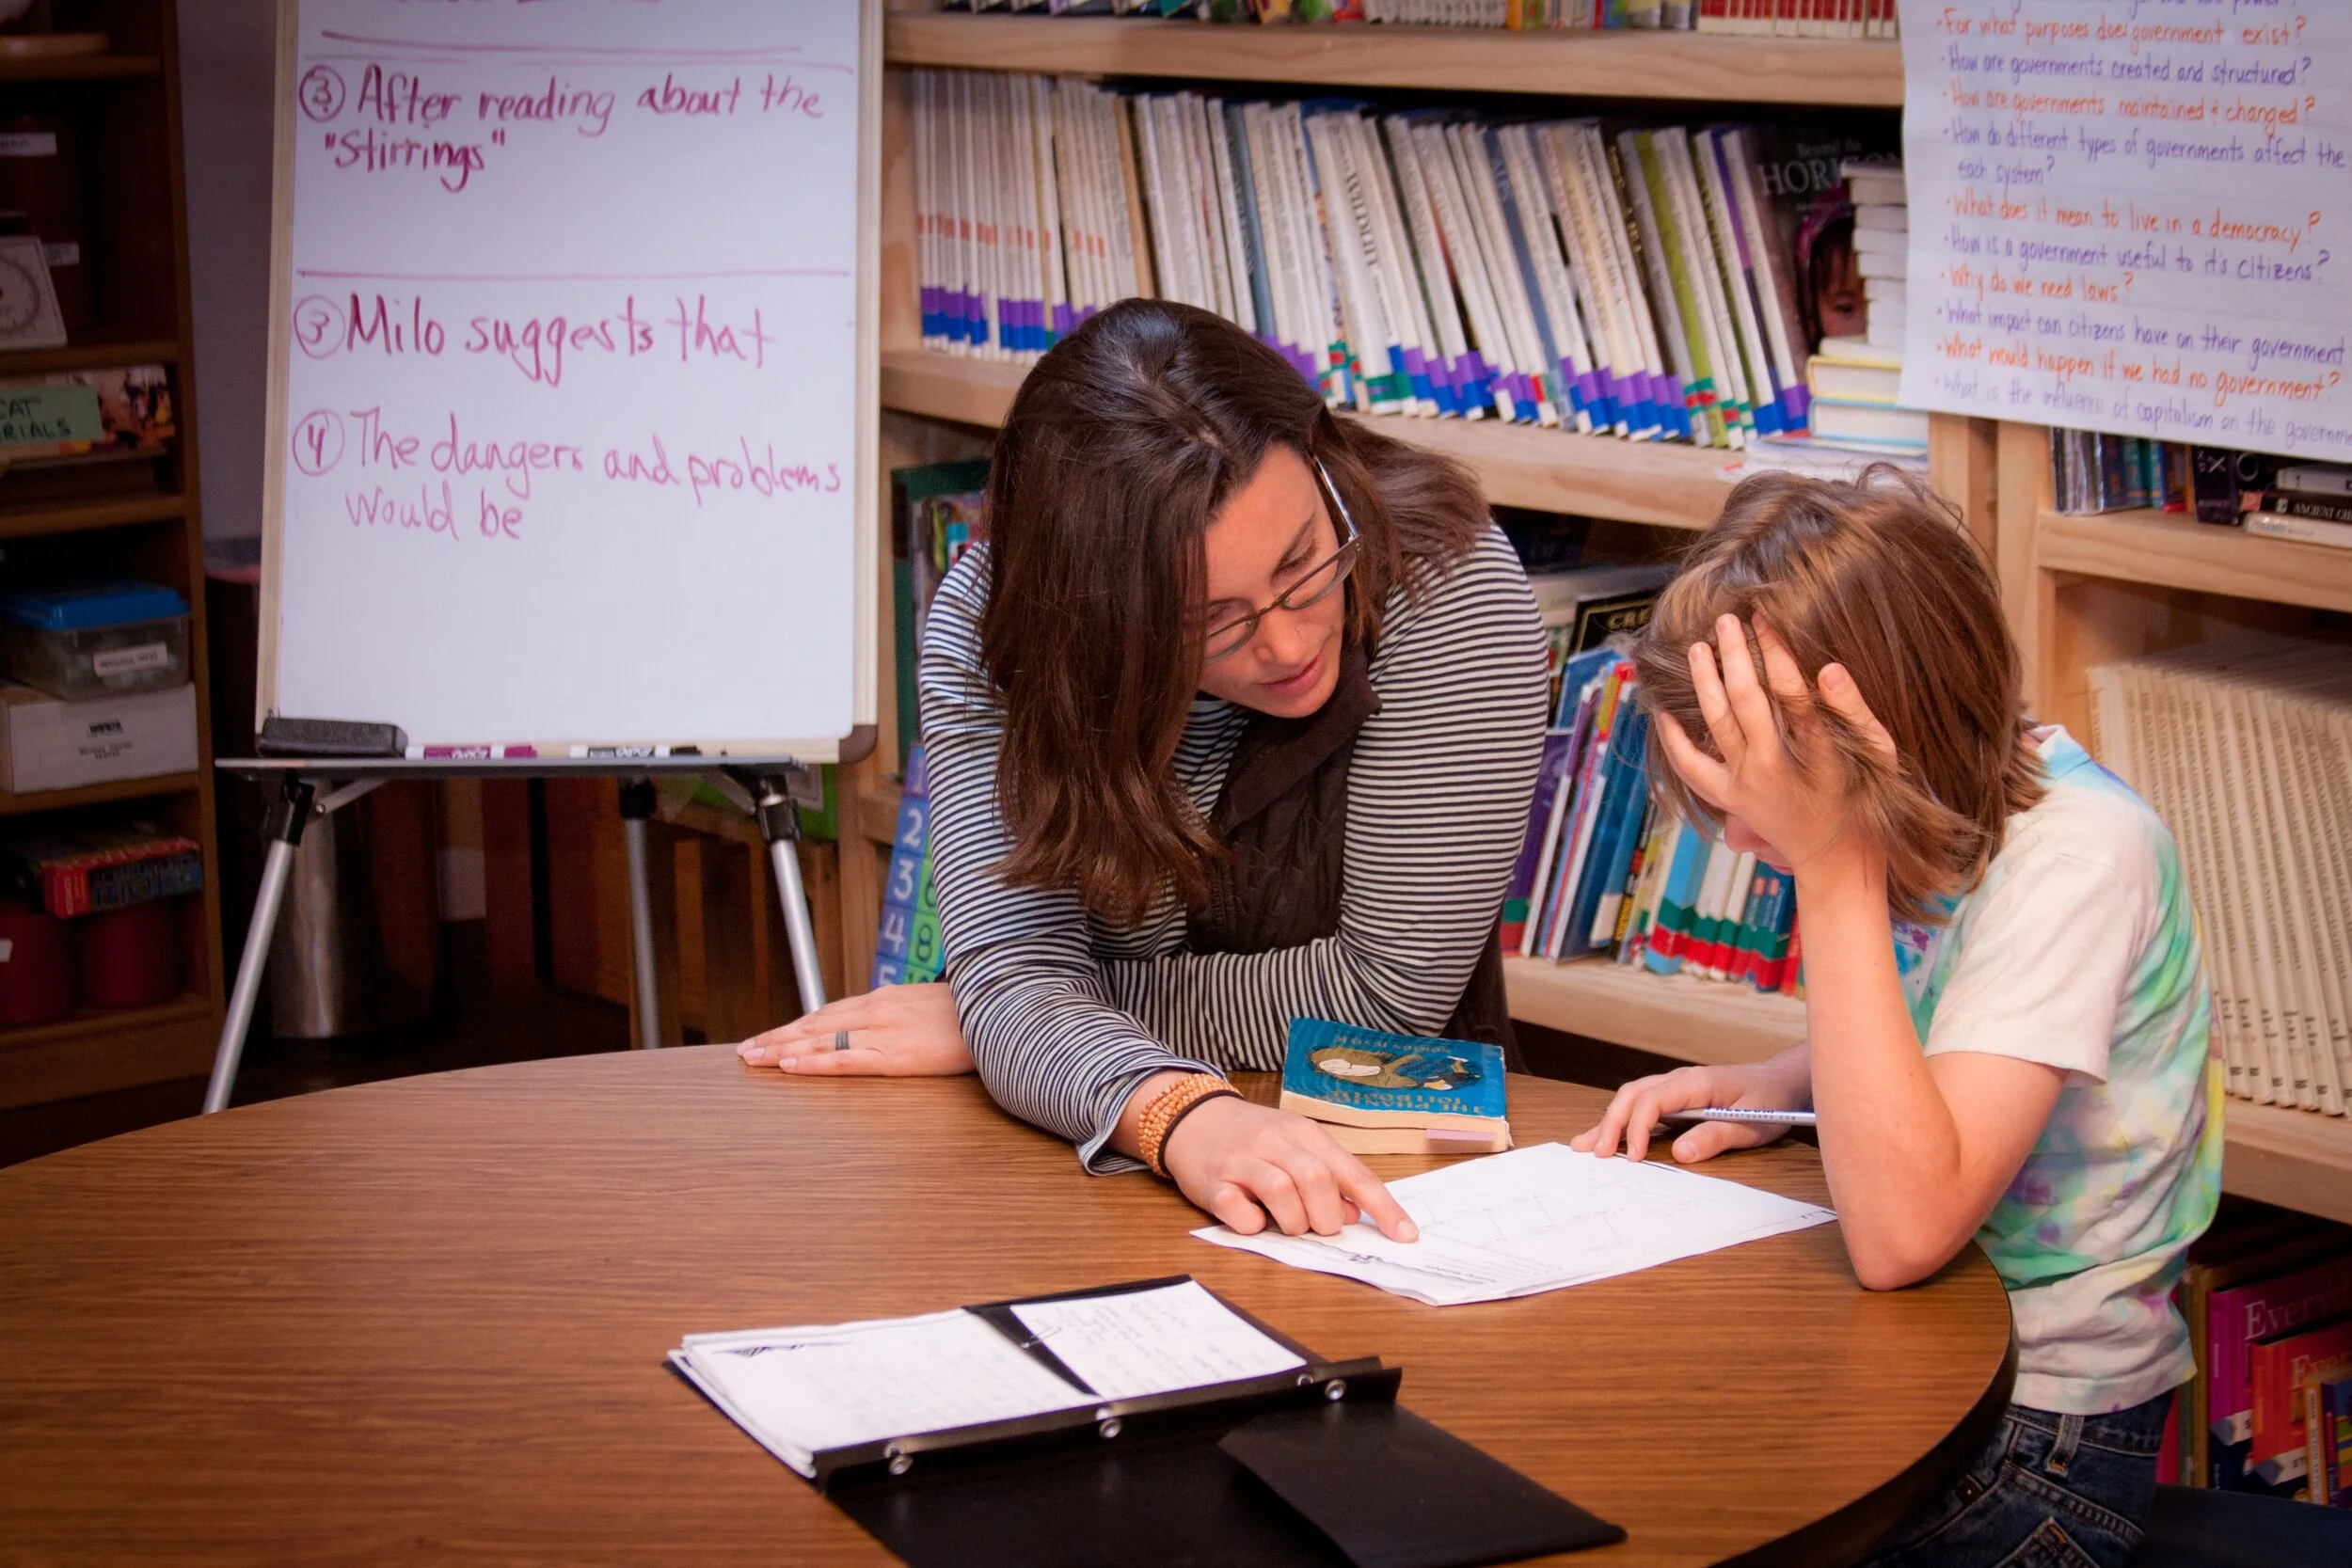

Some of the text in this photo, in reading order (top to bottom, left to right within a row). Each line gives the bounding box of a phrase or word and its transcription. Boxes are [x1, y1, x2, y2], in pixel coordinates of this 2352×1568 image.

[1944, 8, 1972, 35] For
[1980, 8, 2016, 37] what
[2026, 21, 2089, 45] purposes
[2097, 13, 2127, 40] does
[2131, 18, 2224, 55] government
[2243, 15, 2306, 45] exist?
[1949, 42, 2312, 85] How are governments created and structured?
[358, 64, 463, 124] After
[478, 77, 615, 136] reading
[636, 74, 743, 114] about
[758, 74, 824, 119] the
[1952, 77, 1979, 107] How
[1986, 91, 2008, 109] are
[2013, 89, 2105, 122] governments
[2119, 93, 2204, 120] maintained
[2227, 94, 2315, 139] changed?
[324, 130, 505, 193] "Stirrings"
[1952, 115, 2346, 169] How do different types of governments affect the
[1954, 186, 2321, 254] What does it mean to live in a democracy?
[1951, 222, 1980, 254] How
[1987, 235, 1998, 256] is
[2005, 239, 2012, 257] a
[2021, 239, 2107, 273] government
[2118, 240, 2166, 269] useful
[2176, 246, 2193, 273] to
[2204, 246, 2228, 276] it's
[1949, 261, 2135, 303] Why do we need laws?
[347, 292, 445, 356] Milo
[466, 295, 653, 387] suggests
[664, 294, 776, 368] that
[1947, 298, 1982, 325] What
[1988, 309, 2032, 337] impact
[2038, 315, 2061, 335] can
[2070, 312, 2125, 341] citizens
[2135, 314, 2169, 346] have
[2177, 334, 2193, 350] on
[2200, 324, 2243, 354] their
[1944, 331, 2341, 408] What would happen if we had no government?
[2113, 386, 2131, 420] of
[2137, 396, 2214, 431] capitalism
[2221, 415, 2238, 430] on
[2248, 407, 2276, 436] the
[349, 407, 420, 469] The
[431, 411, 582, 500] dangers
[604, 435, 679, 486] and
[688, 436, 841, 507] problems
[480, 488, 522, 540] be
[901, 807, 924, 847] 2
[894, 859, 915, 901] 3
[883, 912, 933, 963] 4 8
